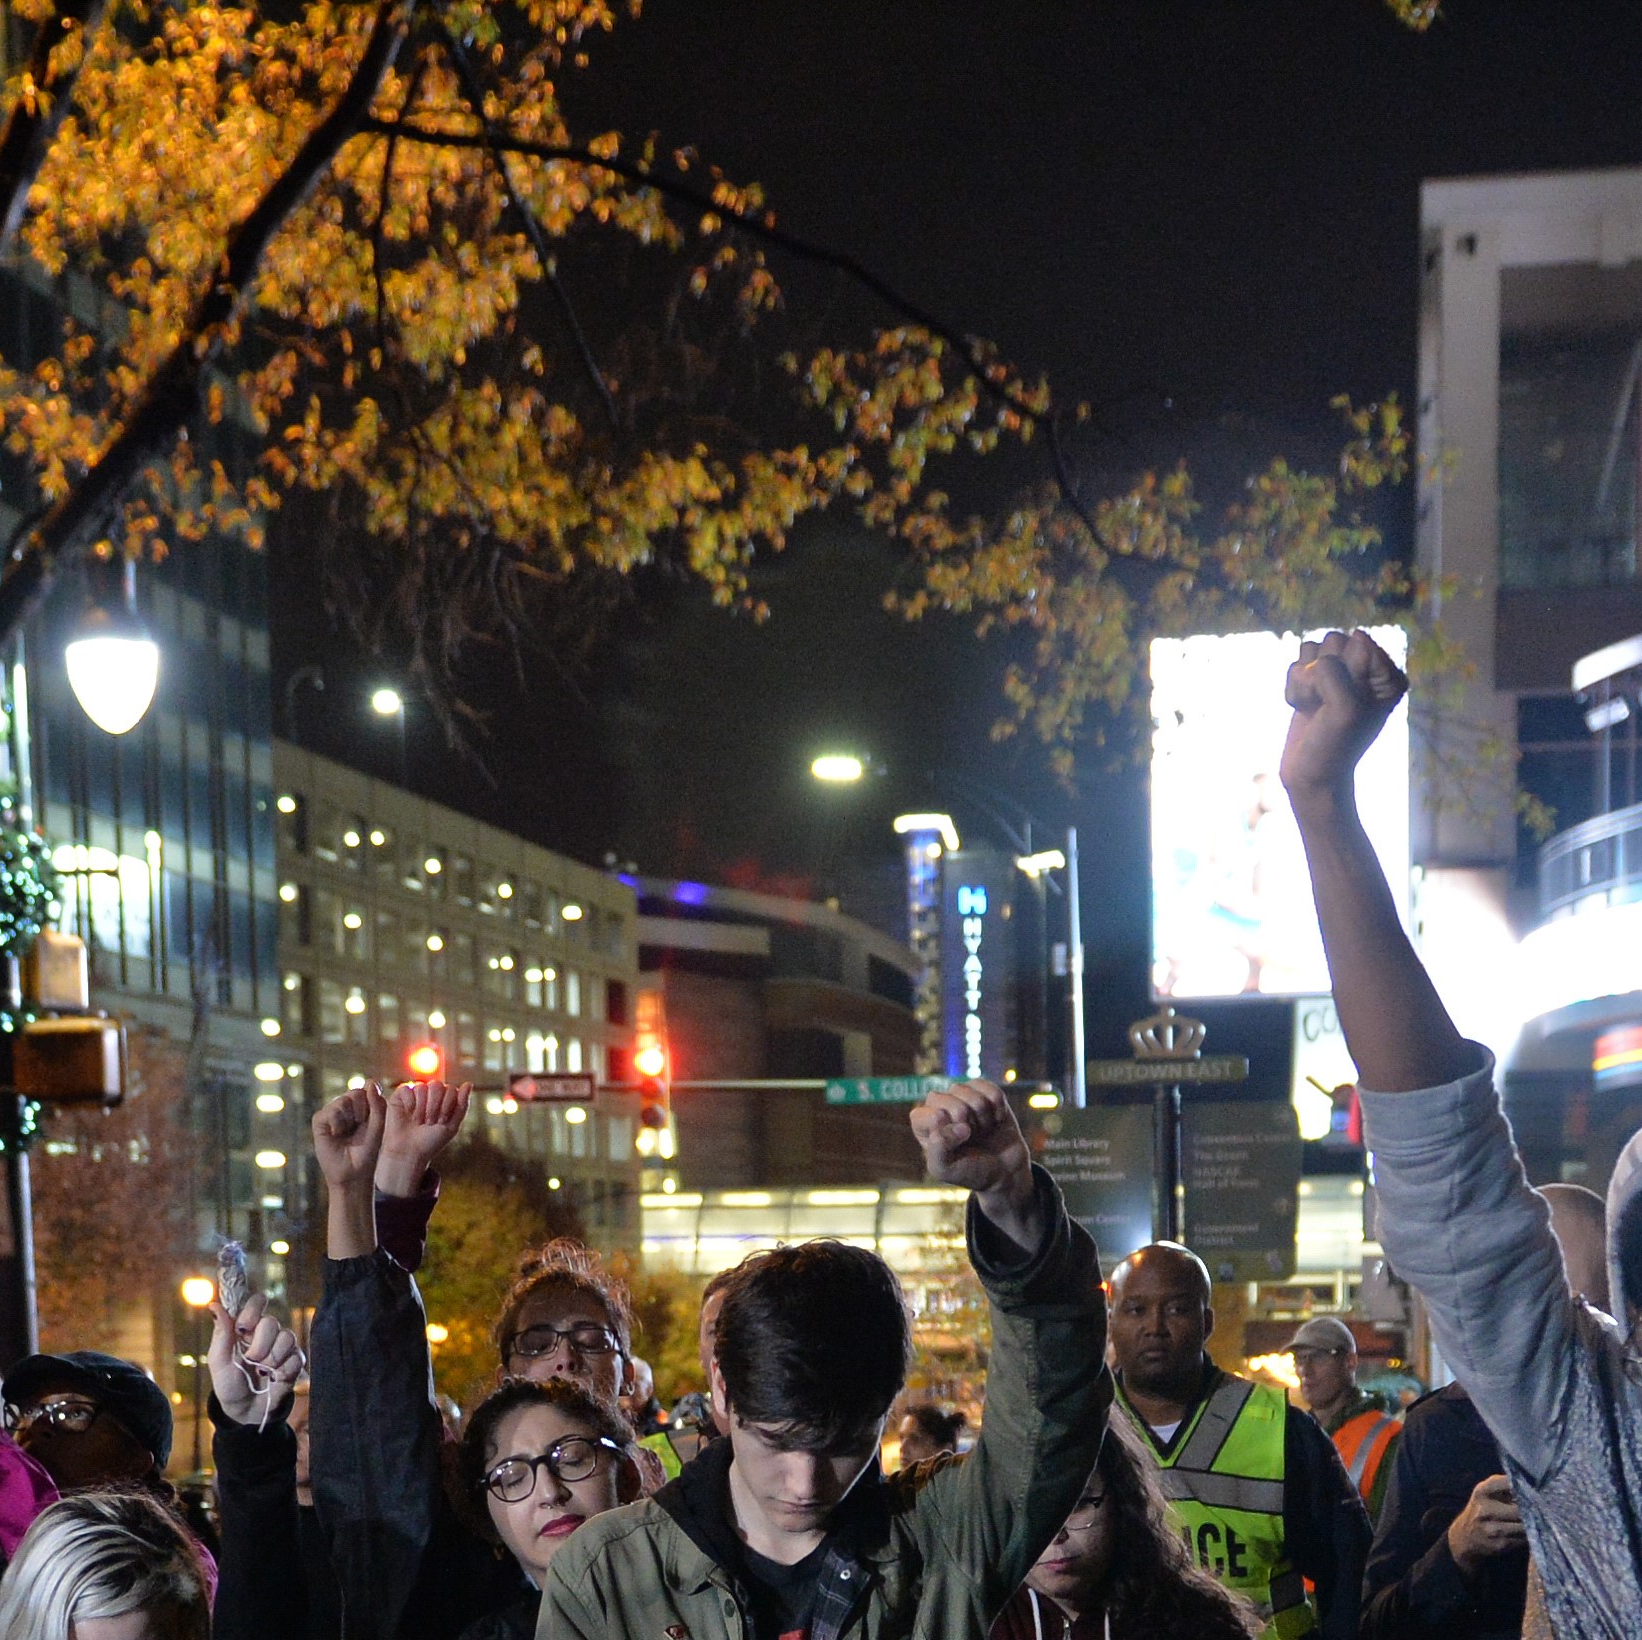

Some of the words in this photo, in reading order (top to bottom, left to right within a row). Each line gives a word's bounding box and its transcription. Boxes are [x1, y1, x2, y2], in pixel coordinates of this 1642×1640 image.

[963, 917, 983, 1011] HYATT
[1100, 1063, 1183, 1081] UPTOWN
[1188, 1061, 1231, 1078] EAST
[1073, 1138, 1109, 1151] Library
